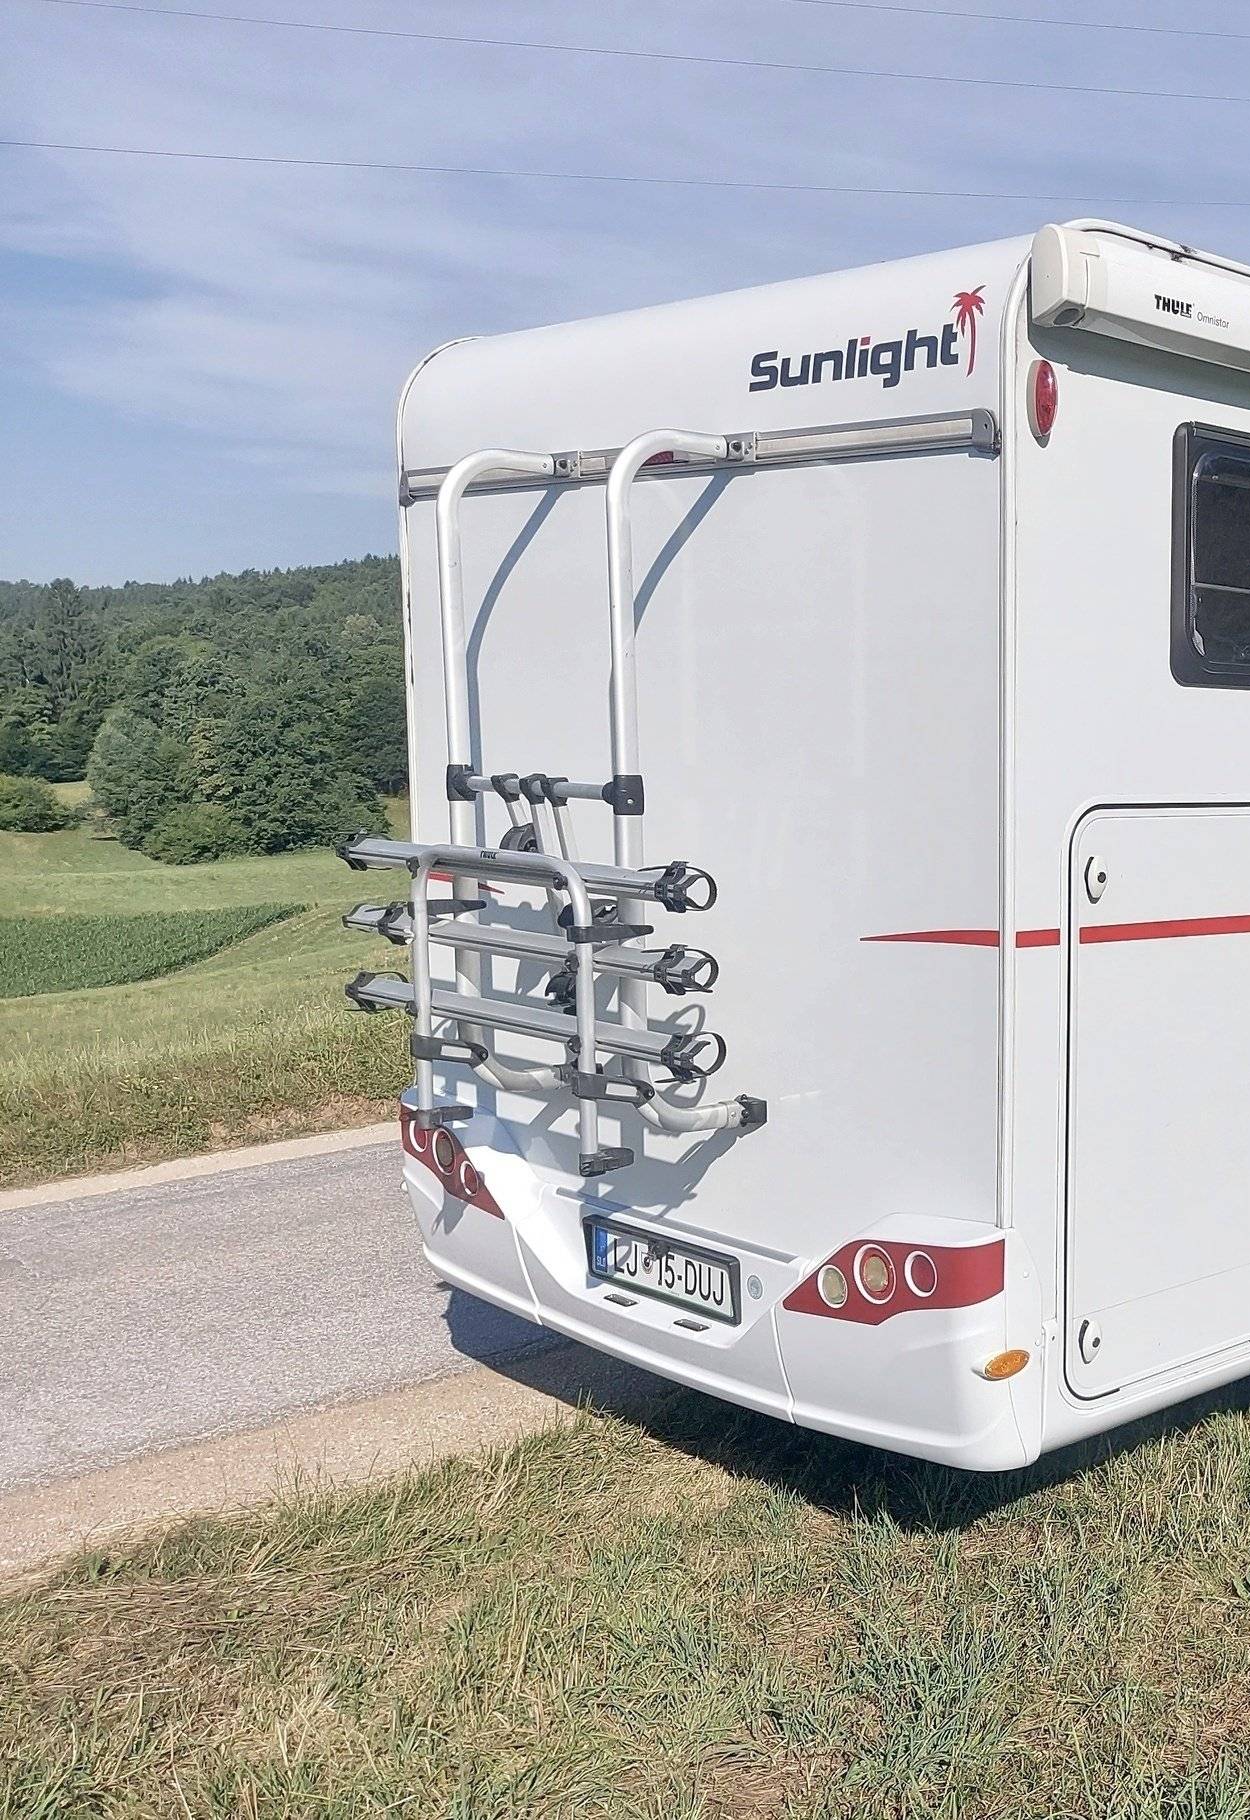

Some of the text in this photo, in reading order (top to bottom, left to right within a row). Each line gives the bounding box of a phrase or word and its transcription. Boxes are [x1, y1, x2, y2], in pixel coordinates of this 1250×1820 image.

[1154, 294, 1230, 329] THULE Omnistor
[748, 323, 959, 393] Sunlight
[613, 1238, 724, 1306] LJ 15-DUJ
